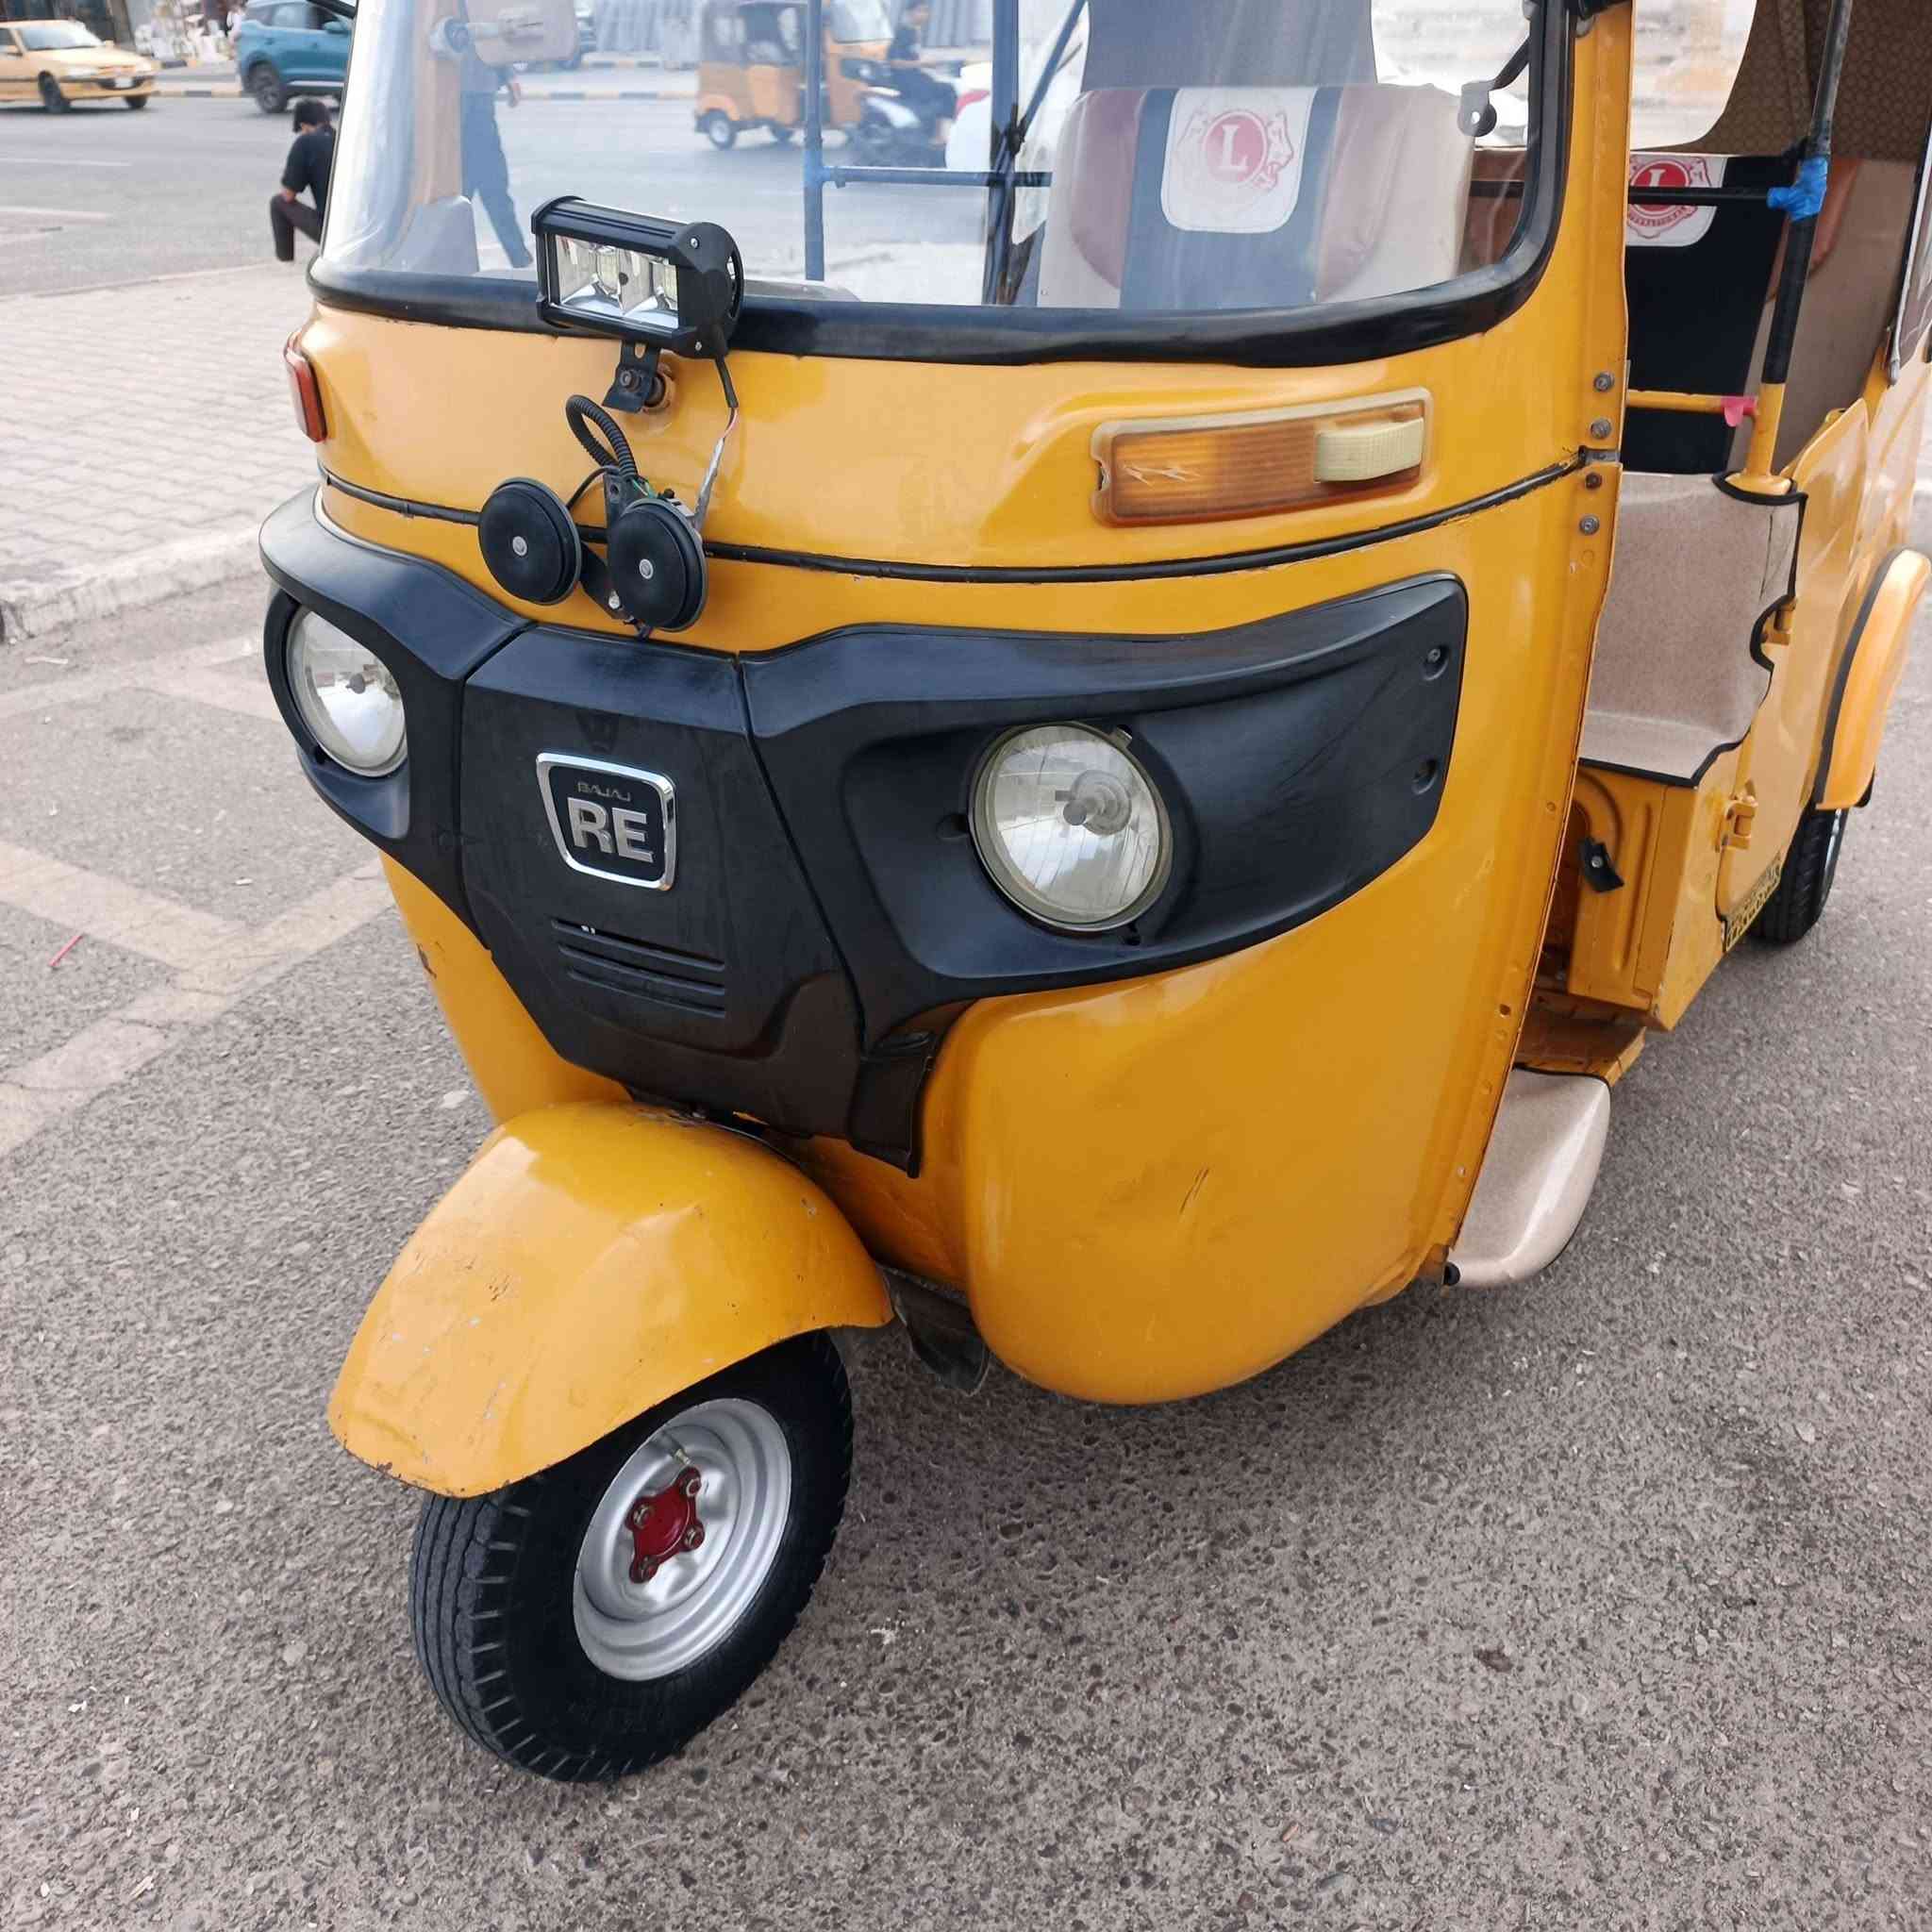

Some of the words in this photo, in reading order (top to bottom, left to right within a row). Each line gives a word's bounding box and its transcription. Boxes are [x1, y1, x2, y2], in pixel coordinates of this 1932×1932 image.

[1219, 124, 1249, 172] L
[577, 781, 631, 802] BAJAJ
[567, 797, 655, 863] RE
